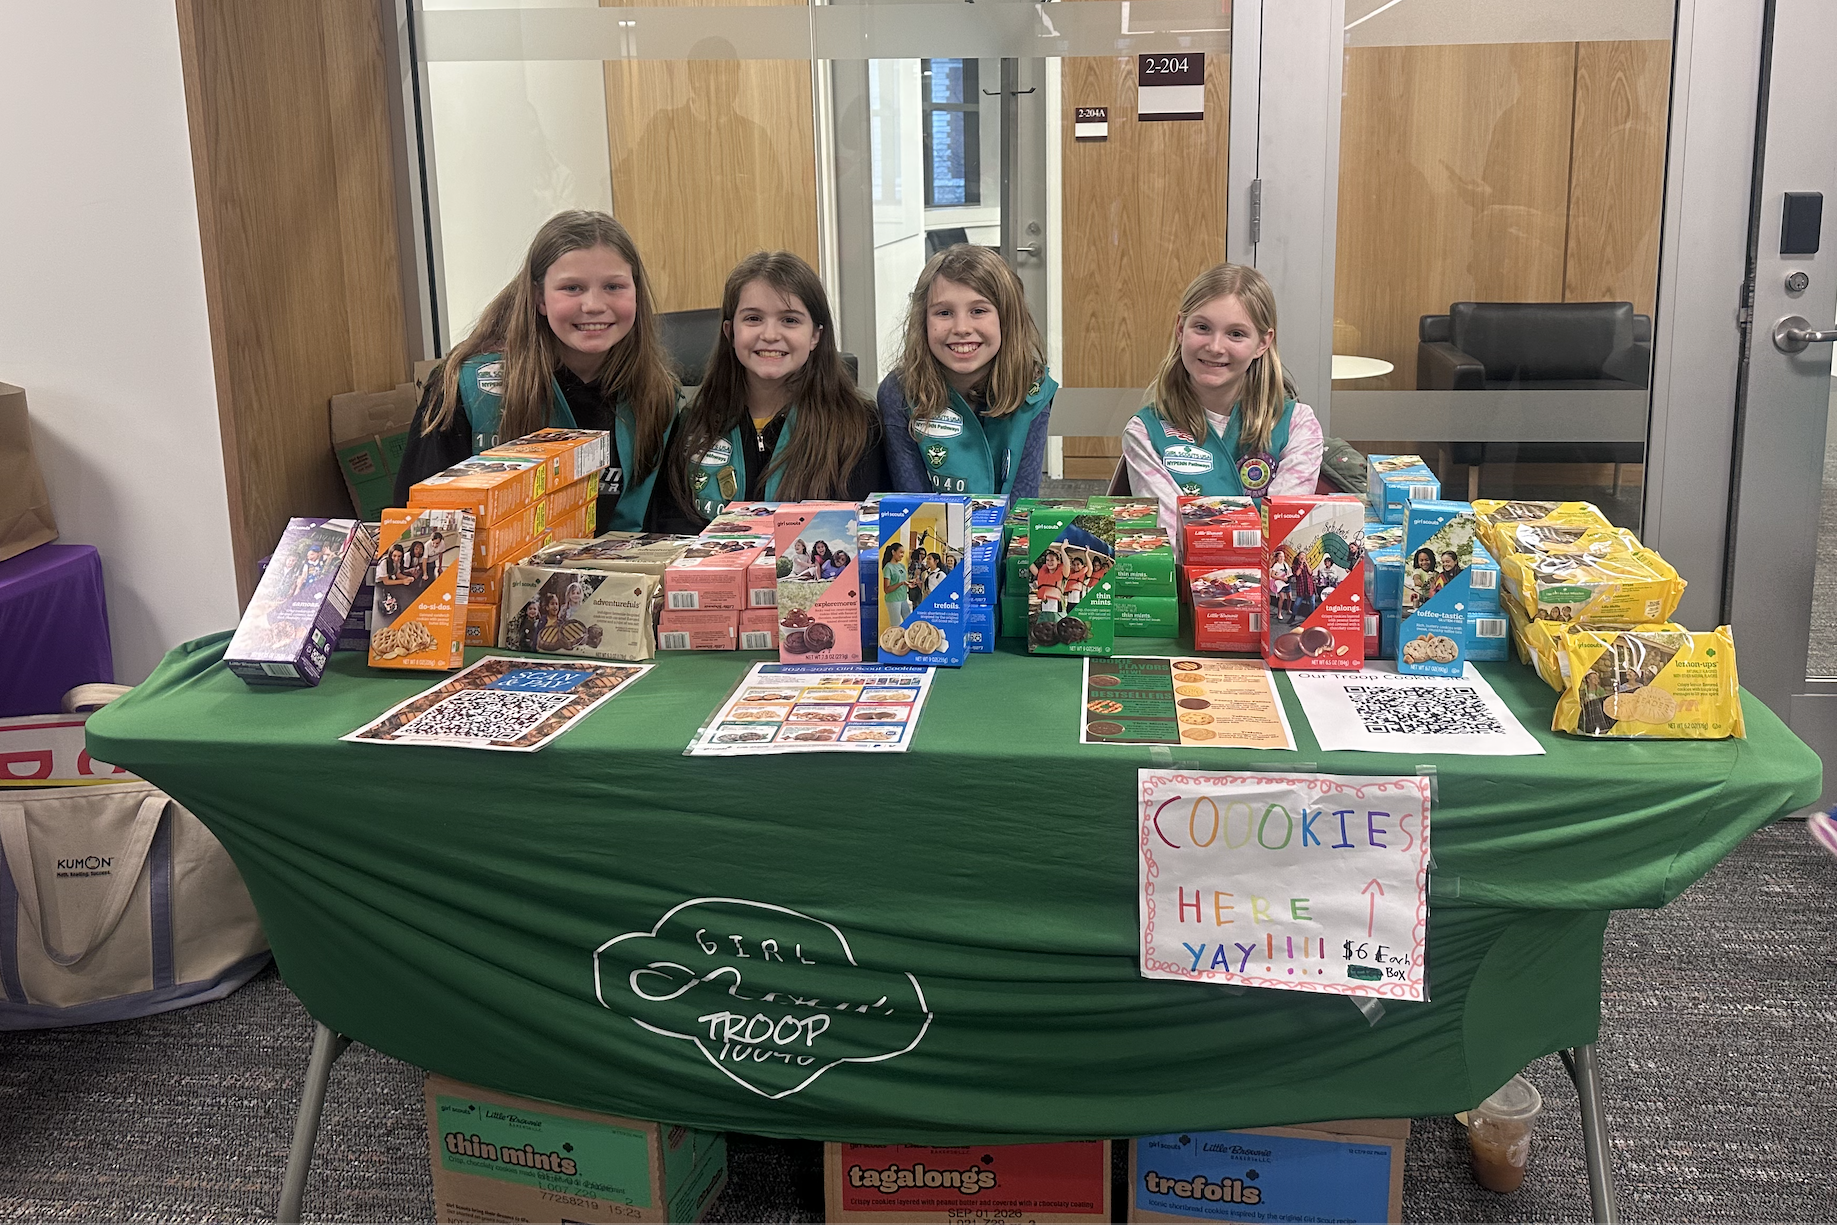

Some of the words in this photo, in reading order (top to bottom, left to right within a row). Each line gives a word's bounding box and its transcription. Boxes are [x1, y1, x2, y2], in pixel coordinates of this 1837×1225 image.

[1145, 57, 1189, 74] 2-204
[1078, 108, 1106, 118] 2-204A
[512, 579, 521, 588] girl
[1096, 592, 1111, 600] thin
[418, 603, 451, 611] do-si-dos
[592, 598, 641, 609] adventurefuls
[814, 600, 858, 609] exploremores
[1325, 604, 1361, 613] tagalongs
[1416, 610, 1465, 620] toffee-tastic
[1118, 663, 1169, 671] FLAVORS
[511, 671, 581, 681] SCAN
[1334, 673, 1379, 681] Troop
[519, 679, 572, 688] PAY
[1090, 690, 1172, 700] BESTSELLERS
[1153, 796, 1414, 852] COOOKIES
[57, 855, 111, 870] KUMON
[1178, 886, 1313, 927] HERE
[695, 928, 816, 965] GIRL
[1342, 939, 1369, 961] $6
[1182, 932, 1326, 975] YAY!!!!
[1385, 967, 1406, 981] Box
[698, 1010, 831, 1047] TROOP
[441, 1104, 451, 1112] girl
[452, 1106, 471, 1115] scouts
[485, 1110, 506, 1121] Little
[507, 1114, 542, 1127] Brownie
[1148, 1141, 1160, 1149] girl
[1202, 1142, 1228, 1153] Little
[1228, 1145, 1272, 1157] Brownie
[444, 1131, 499, 1161] thin
[500, 1143, 578, 1176] mints
[848, 1163, 998, 1195] tagalongs
[1144, 1170, 1262, 1205] trefoils
[540, 1190, 599, 1210] 77258219
[609, 1204, 642, 1219] 15:23
[850, 1198, 871, 1206] Crispy
[896, 1198, 920, 1206] layered
[1018, 1199, 1032, 1207] with
[1038, 1200, 1069, 1208] chocolaty
[1070, 1201, 1094, 1209] coating
[948, 1208, 972, 1218] SEP
[975, 1208, 988, 1218] 01
[993, 1208, 1022, 1218] 2026
[1148, 1199, 1167, 1208] Iconic
[1168, 1201, 1203, 1213] shortbread
[1204, 1206, 1229, 1215] cookies
[1230, 1208, 1256, 1220] inspired
[1257, 1211, 1265, 1220] by
[1266, 1212, 1278, 1220] the
[1278, 1212, 1303, 1223] original
[1303, 1215, 1316, 1223] Girl
[1316, 1216, 1336, 1224] Scout
